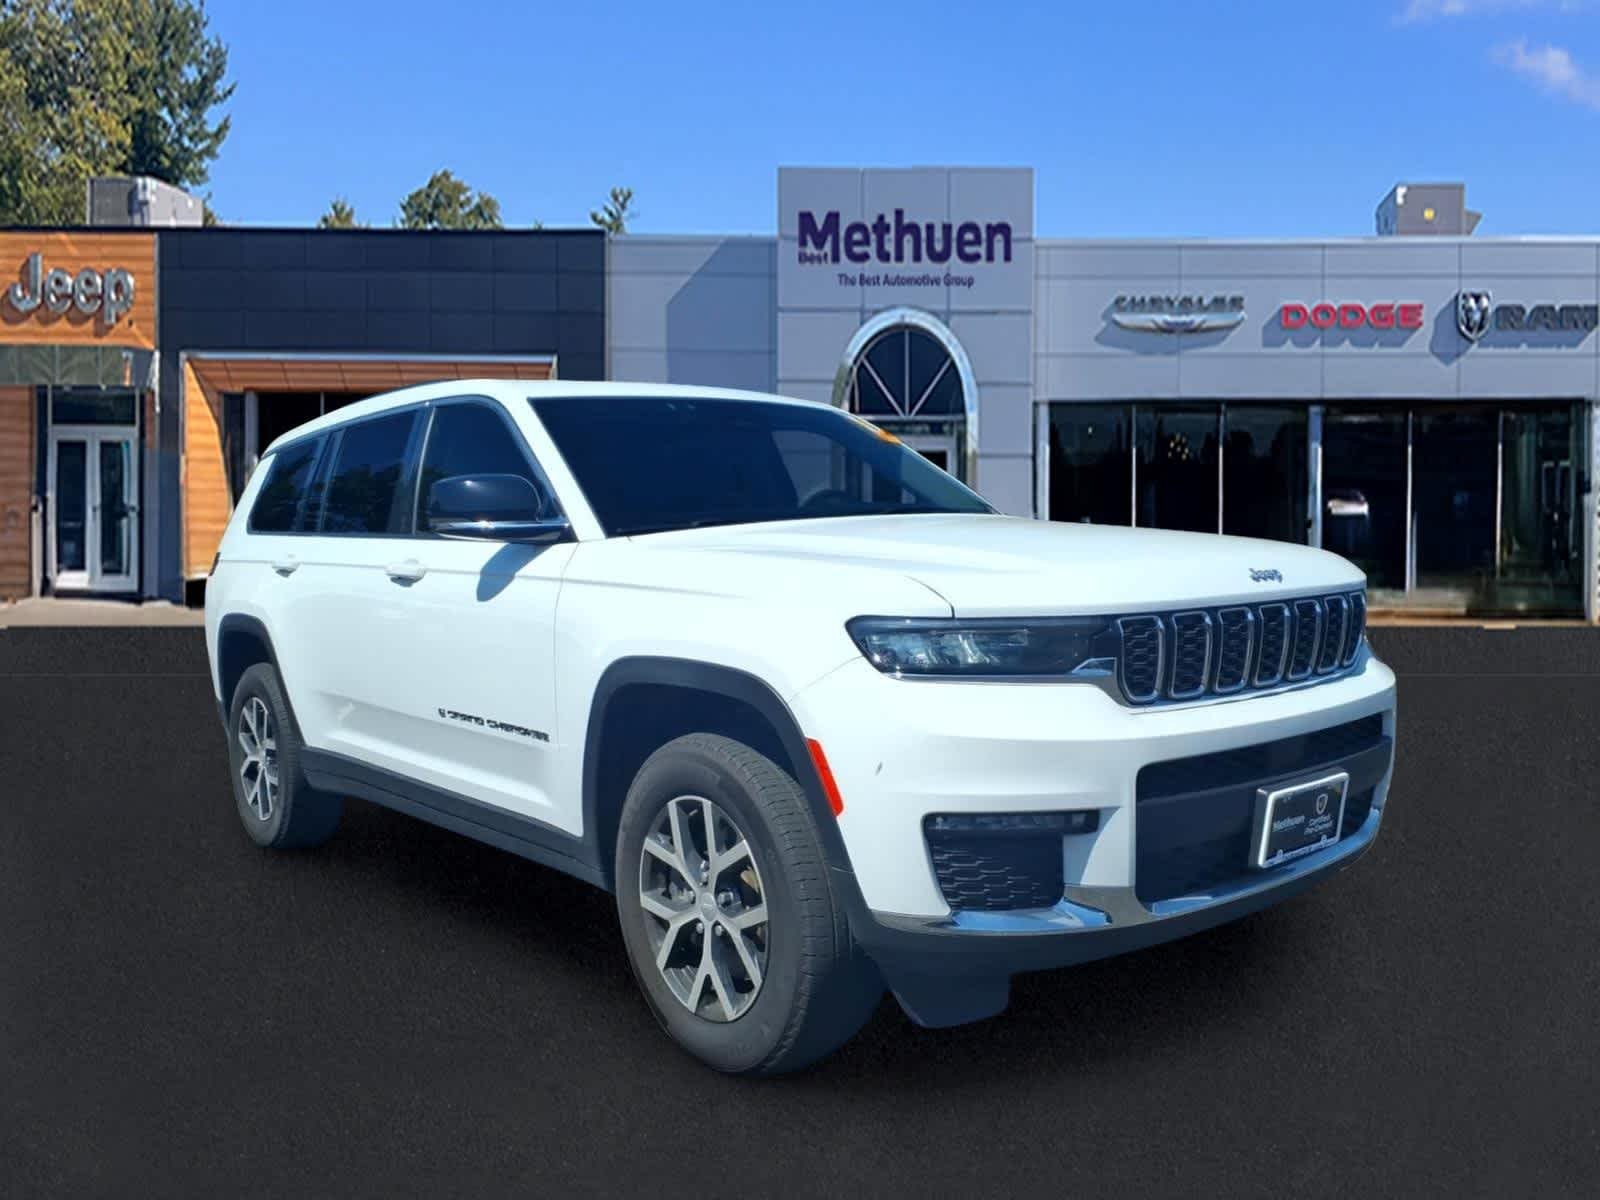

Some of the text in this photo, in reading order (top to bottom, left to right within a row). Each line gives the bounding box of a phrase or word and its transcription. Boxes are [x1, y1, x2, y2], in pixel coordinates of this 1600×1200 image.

[798, 208, 1012, 264] Methuen
[9, 251, 135, 325] Jeep
[837, 273, 975, 291] The Best Automotive Group
[1114, 295, 1245, 313] CHRYSLER
[1281, 303, 1424, 329] DODGE
[1494, 303, 1599, 331] RAM
[1249, 568, 1283, 583] Jeep
